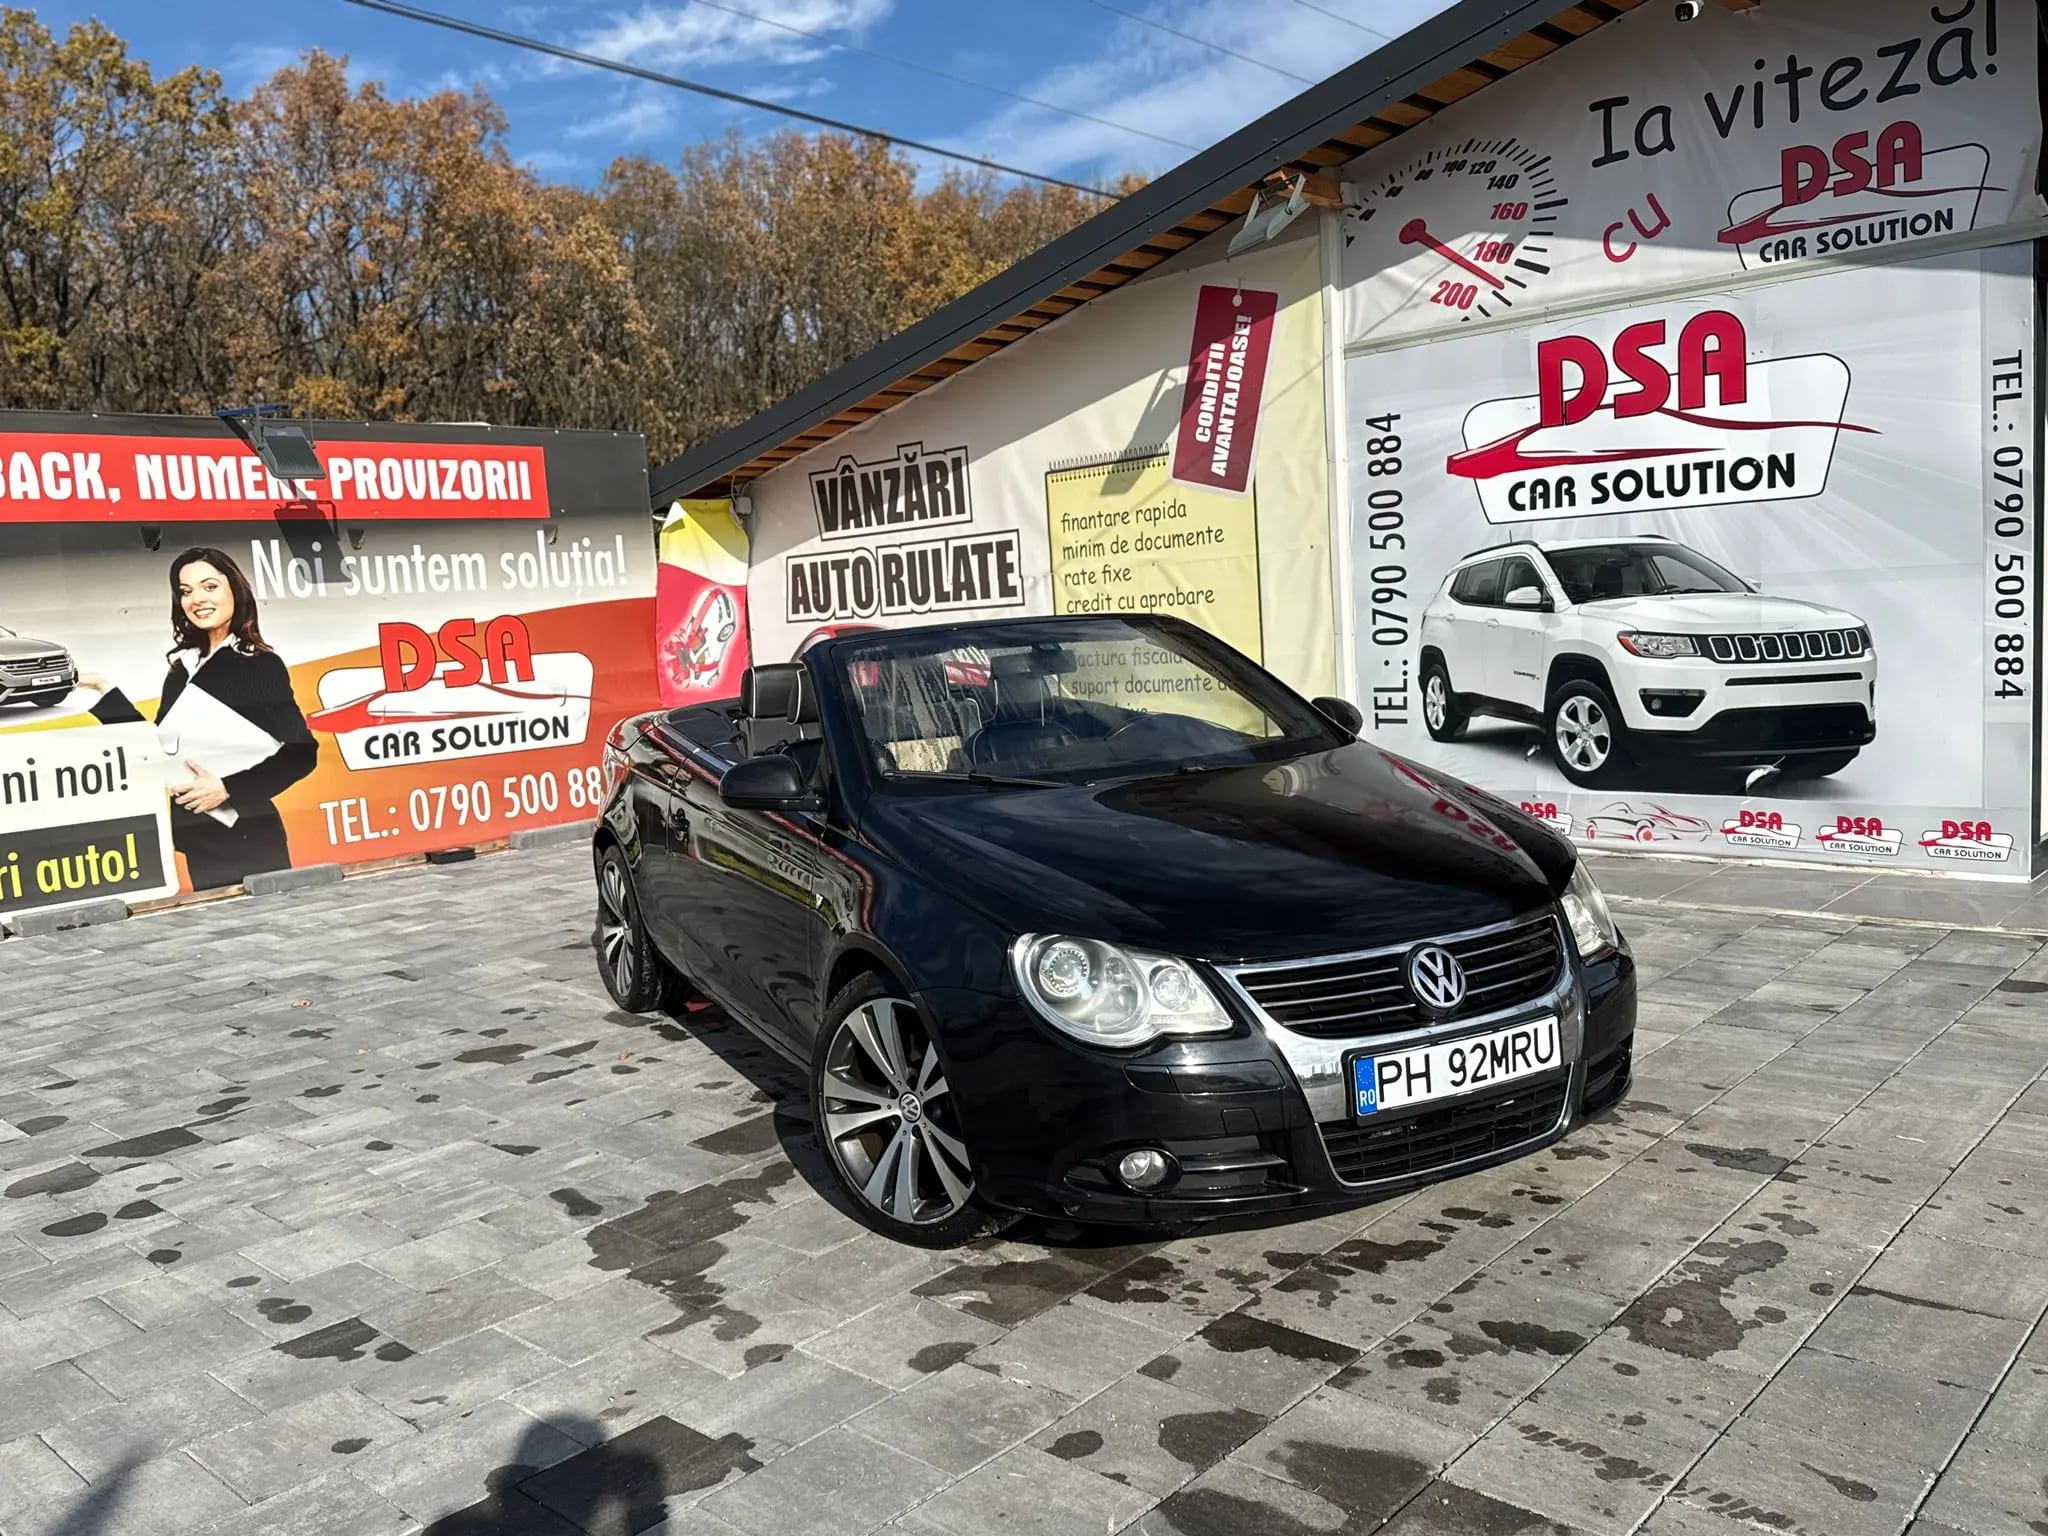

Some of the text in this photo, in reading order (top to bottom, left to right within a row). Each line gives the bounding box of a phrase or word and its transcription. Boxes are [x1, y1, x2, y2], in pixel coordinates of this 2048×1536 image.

[1588, 0, 1999, 168] Ia viteză!
[1441, 158, 1468, 173] 100
[1468, 160, 1497, 175] 120
[1486, 173, 1520, 190] 140
[1780, 120, 1923, 207] DSA
[1490, 201, 1528, 220] 160
[1602, 192, 1672, 264] cu
[1473, 240, 1515, 264] 180
[1759, 207, 1954, 264] CAR SOLUTION
[1430, 279, 1479, 310] 200
[1537, 309, 1748, 429] DSA
[1195, 342, 1226, 443] CONDITII
[1210, 314, 1253, 478] AVANTAJOASE!
[0, 451, 121, 504] ACK,
[327, 457, 533, 501] PROVIZORII
[815, 450, 967, 533] VÂNZĂRI
[1507, 452, 1796, 512] CAR SOLUTION
[1060, 498, 1187, 534] finantare rapida
[1991, 348, 2025, 700] TEL.: 0790 500 884
[1062, 525, 1225, 561] minim de documente
[251, 538, 328, 600] Noi
[342, 544, 488, 596] suntem
[791, 539, 1018, 616] AUTO RULATE
[1064, 563, 1132, 587] rate fixe
[1365, 412, 1409, 730] TEL.: 0790 500 884
[1066, 586, 1216, 614] credit cu aprobare
[378, 614, 535, 694] DSA
[1075, 650, 1127, 668] actura
[1071, 676, 1119, 700] suport
[1124, 672, 1213, 694] documente
[364, 714, 570, 760] CAR SOLUTION
[55, 746, 129, 799] noi!
[319, 796, 401, 846] TEL.:
[409, 780, 492, 832] 0790
[503, 771, 559, 818] 500
[1740, 809, 1783, 831] DSA
[1837, 815, 1883, 837] DSA
[1941, 820, 1992, 841] DSA
[36, 832, 140, 894] auto!
[1732, 835, 1792, 847] CAR SOLUTION
[1829, 842, 1892, 854] CAR SOLUTION
[1934, 847, 2002, 859] CAR SOLUTION
[1376, 1023, 1556, 1099] PH 92MRU
[1359, 1090, 1376, 1107] RO
